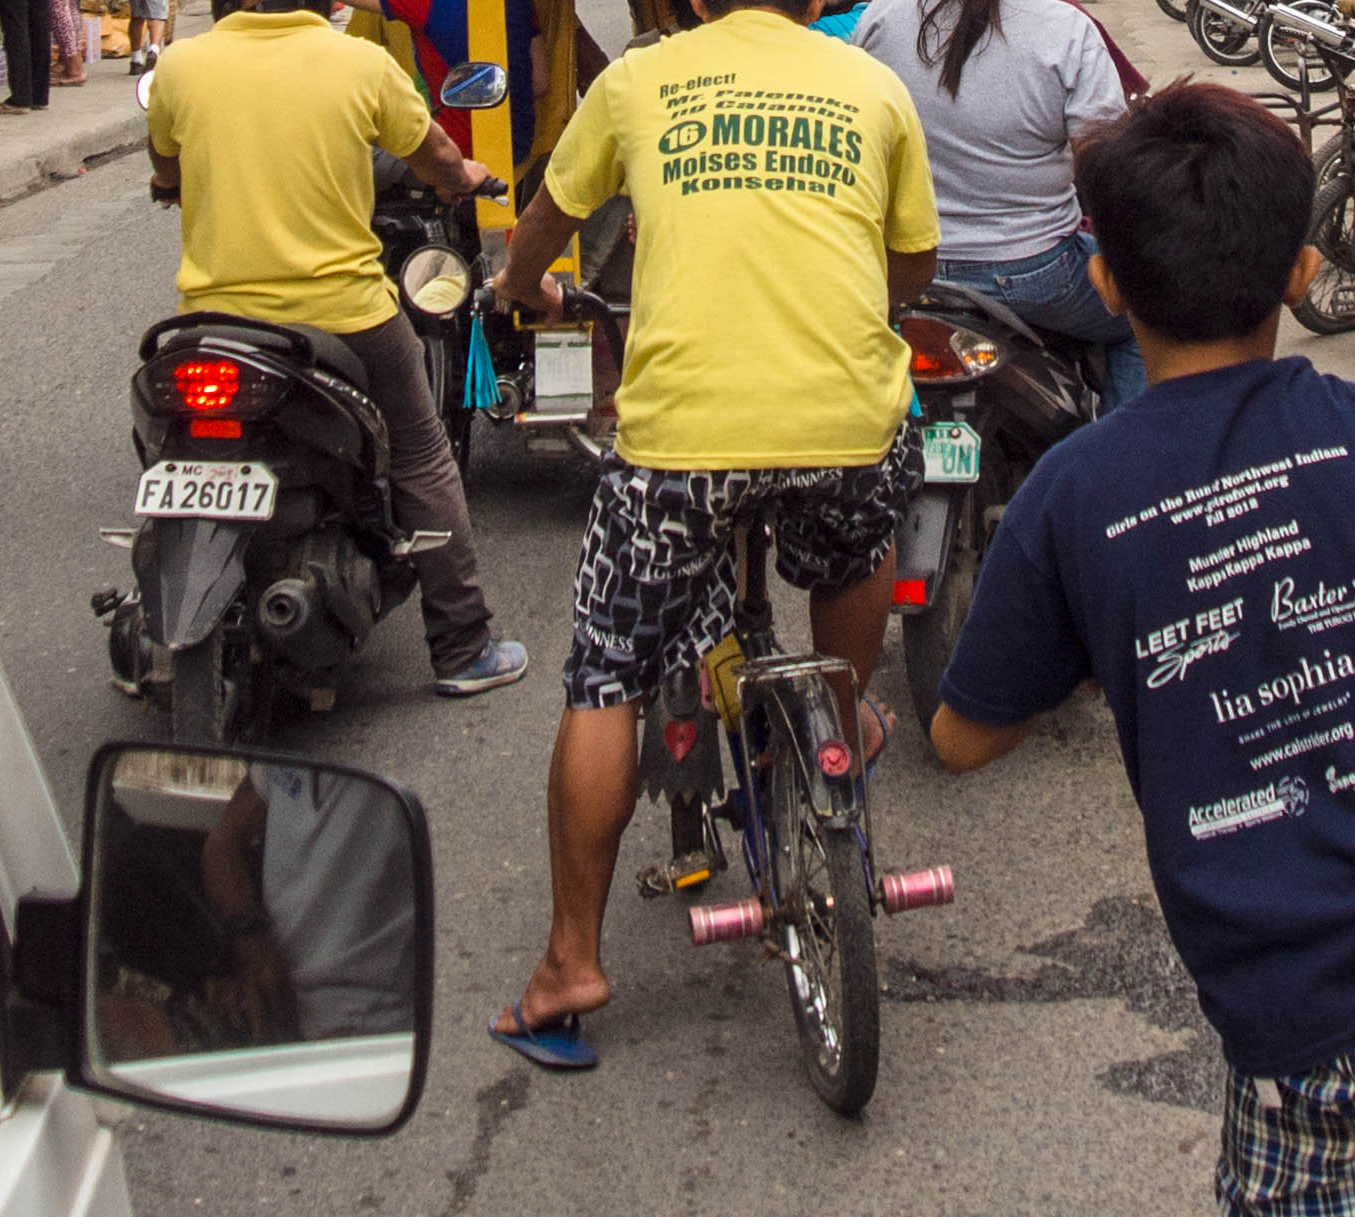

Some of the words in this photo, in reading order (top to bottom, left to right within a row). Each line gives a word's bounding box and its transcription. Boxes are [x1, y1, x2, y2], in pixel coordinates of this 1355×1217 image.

[659, 73, 736, 99] Re-elect!
[714, 90, 861, 115] Palengke
[670, 104, 707, 120] ng
[716, 100, 855, 124] Calamba
[664, 126, 699, 151] 16
[712, 115, 863, 165] MORALES
[663, 151, 757, 186] Moises
[765, 151, 857, 187] Endozo
[681, 176, 837, 198] Konsehal
[181, 465, 203, 476] MC
[1105, 514, 1138, 540] Girls
[1138, 506, 1159, 521] on
[1159, 494, 1184, 513] the
[1220, 455, 1293, 492] Northwest
[1294, 444, 1349, 468] Indiana
[1235, 519, 1300, 553] Highland
[1266, 537, 1312, 564] Kappa
[1270, 576, 1348, 623] Baxter
[1135, 616, 1190, 659] LEET
[1195, 597, 1245, 635] FEET
[1209, 690, 1256, 724] lia
[1188, 782, 1278, 827] Accelerated
